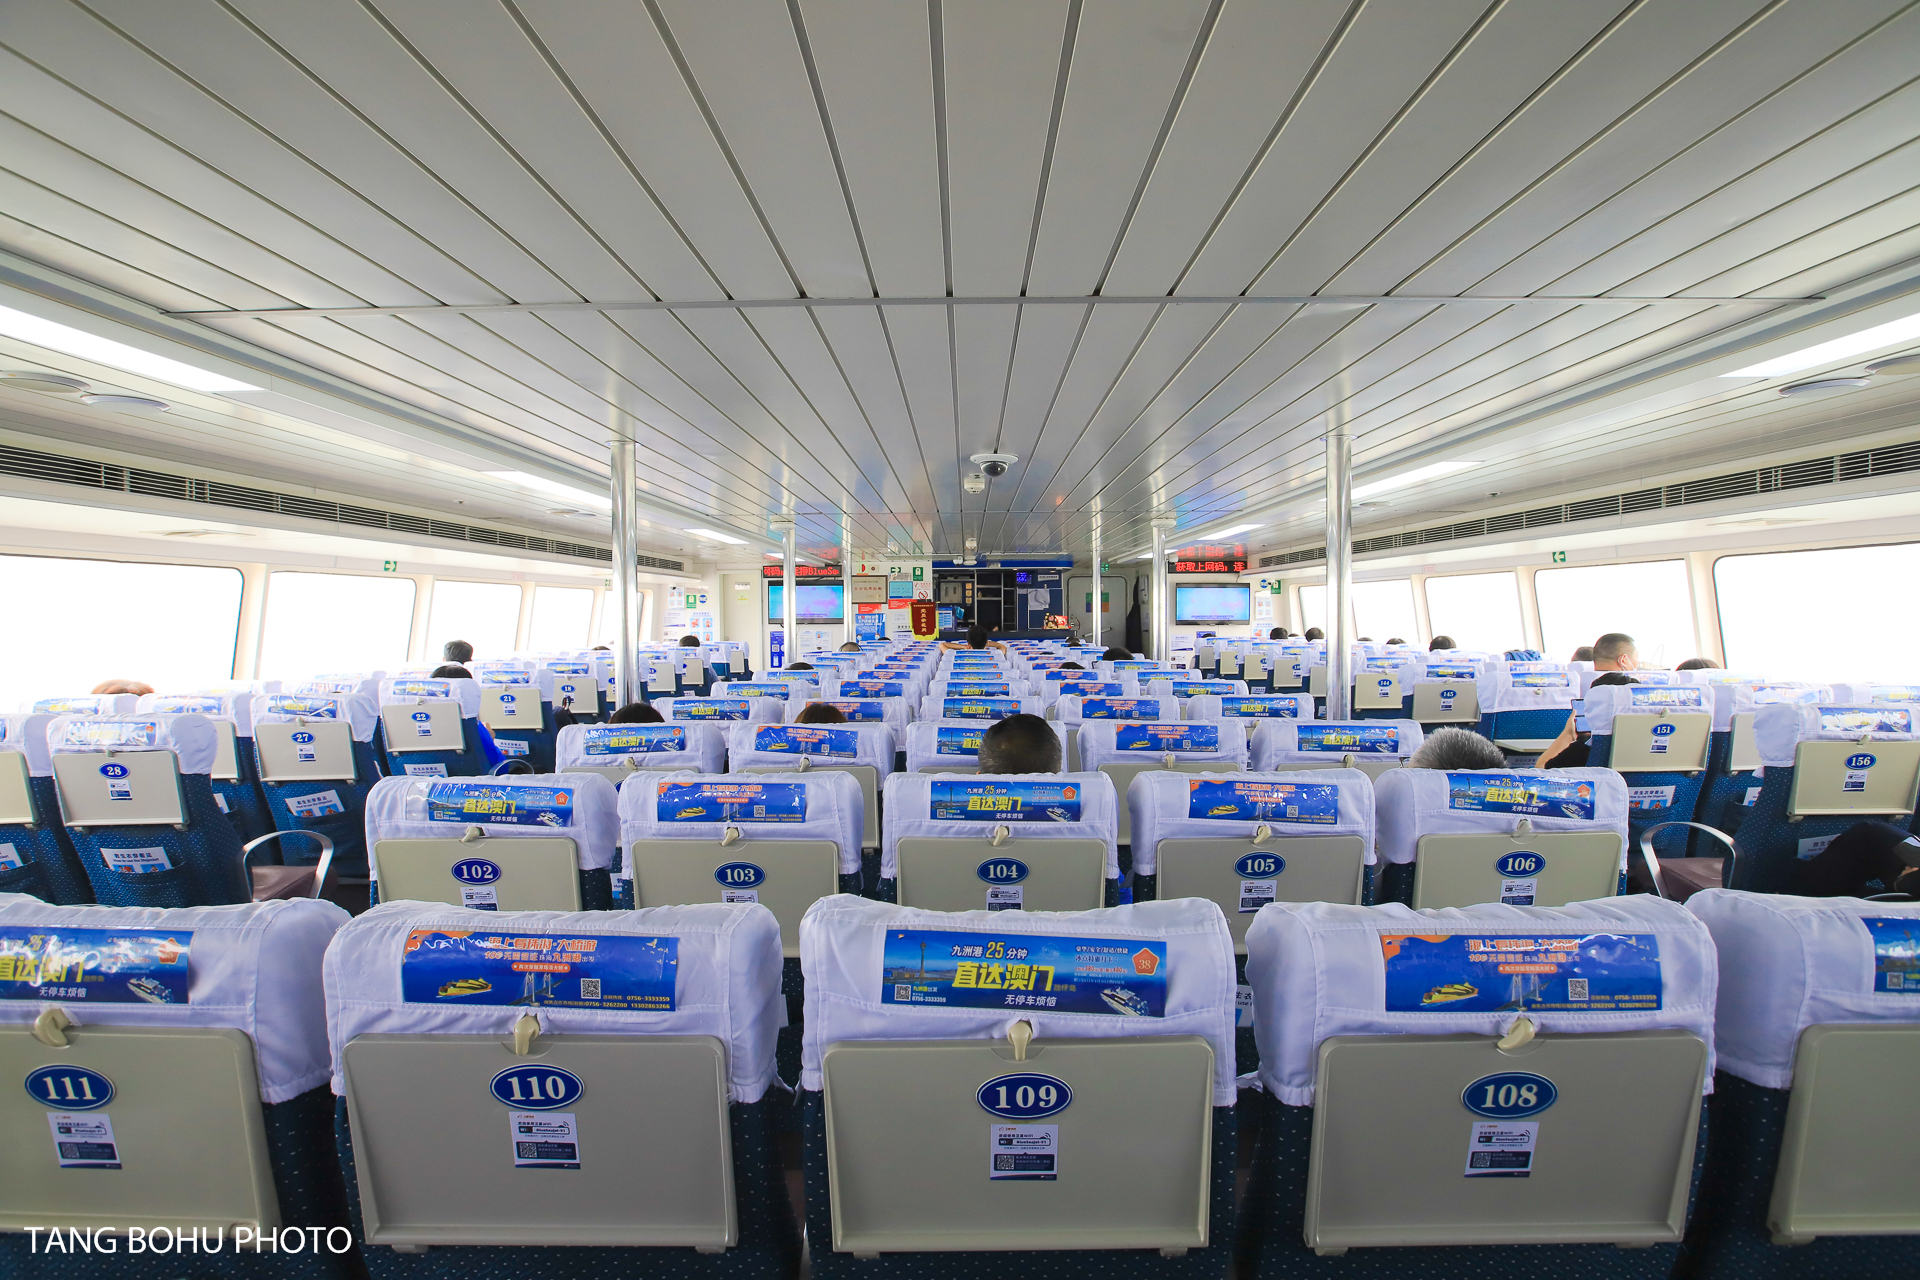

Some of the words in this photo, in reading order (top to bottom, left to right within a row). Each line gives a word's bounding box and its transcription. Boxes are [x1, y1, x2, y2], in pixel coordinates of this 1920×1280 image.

[296, 733, 309, 742] 27
[1656, 726, 1671, 734] 151
[610, 736, 646, 748] 直达澳门
[1323, 735, 1360, 746] 直达澳门
[1850, 757, 1871, 766] 156
[106, 766, 122, 776] 28
[984, 785, 995, 795] 25
[1502, 778, 1512, 787] 25
[480, 788, 491, 798] 25
[1485, 787, 1539, 804] 直达澳门
[462, 798, 516, 814] 直达澳门
[967, 796, 1022, 812] 直达澳门
[460, 864, 494, 879] 102
[987, 864, 1018, 879] 104
[1245, 858, 1276, 874] 105
[1505, 857, 1536, 872] 106
[725, 868, 756, 883] 103
[951, 944, 983, 958] 九洲港
[985, 941, 1005, 960] 25
[1006, 948, 1028, 960] 分钟
[1138, 958, 1152, 970] 38
[951, 960, 1055, 992] 直达澳门
[40, 986, 88, 998] 无停车烦恼
[1004, 994, 1057, 1007] 无停车烦恼
[42, 1076, 97, 1100] 111
[508, 1076, 566, 1100] 110
[995, 1085, 1058, 1108] 109
[1480, 1084, 1538, 1108] 108
